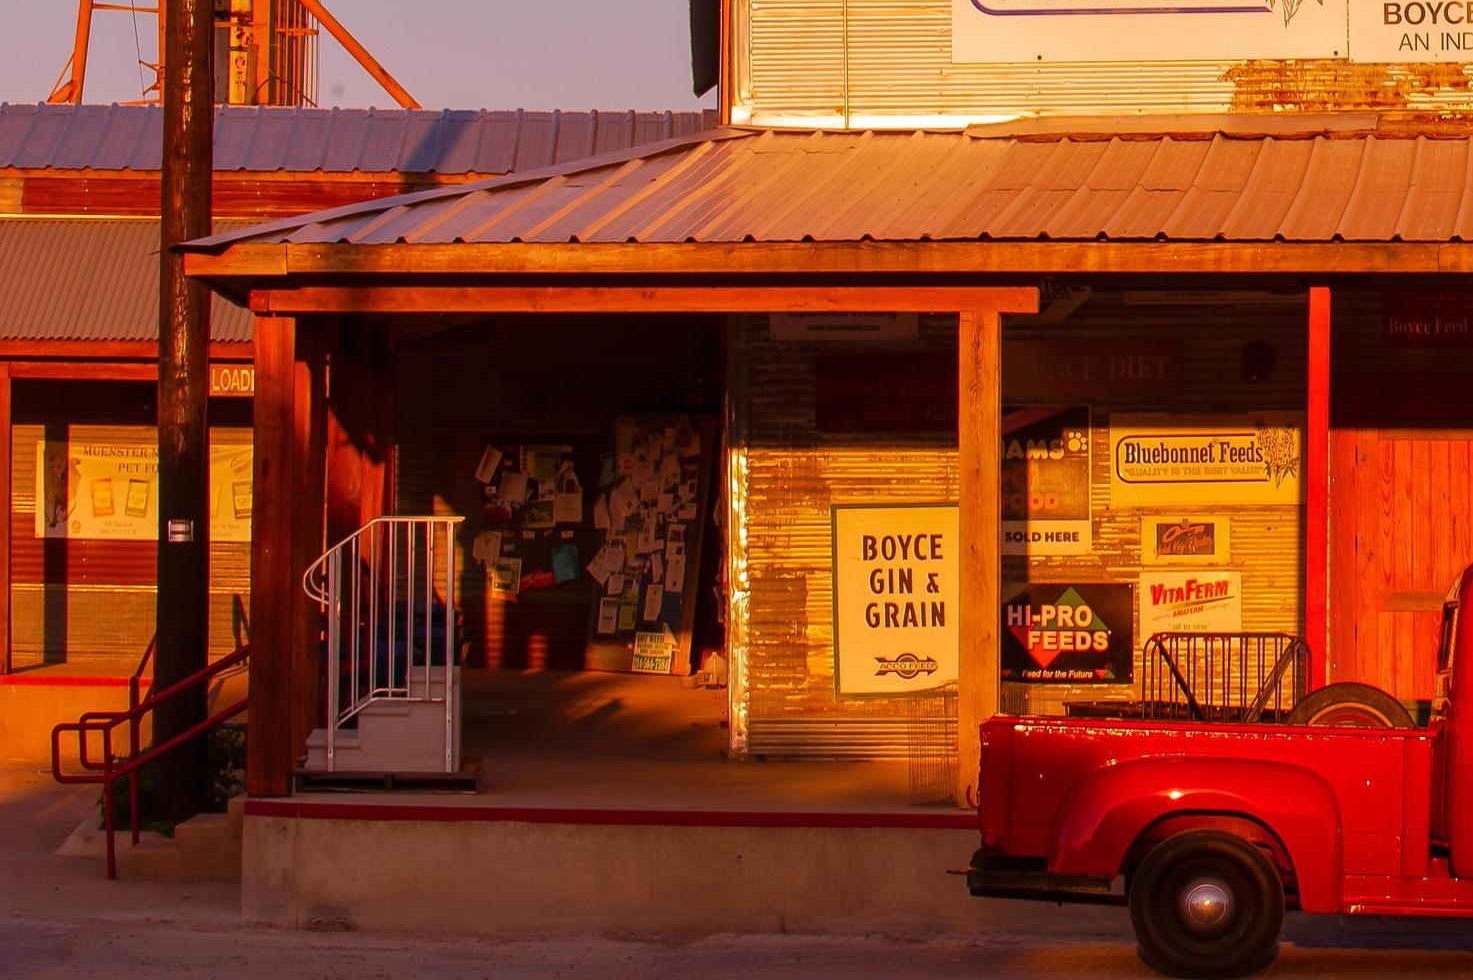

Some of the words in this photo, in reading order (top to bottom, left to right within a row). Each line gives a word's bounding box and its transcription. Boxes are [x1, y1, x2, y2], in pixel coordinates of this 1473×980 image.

[1398, 32, 1430, 51] AN
[83, 446, 148, 458] MUENSTER
[1124, 442, 1215, 464] Bluebonnet
[1219, 441, 1263, 463] Feeds
[118, 463, 141, 473] PET
[862, 533, 944, 561] BOYCE
[1004, 531, 1042, 542] SOLD
[1045, 531, 1080, 542] HERE
[869, 568, 913, 595] GIN
[926, 573, 940, 594] &
[865, 601, 945, 629] GRAIN
[1007, 604, 1093, 628] HI-PRO
[1028, 630, 1109, 652] FEEDS
[1022, 670, 1041, 678] Feed
[1042, 670, 1054, 678] for
[1054, 670, 1067, 678] the
[1068, 670, 1093, 678] Future
